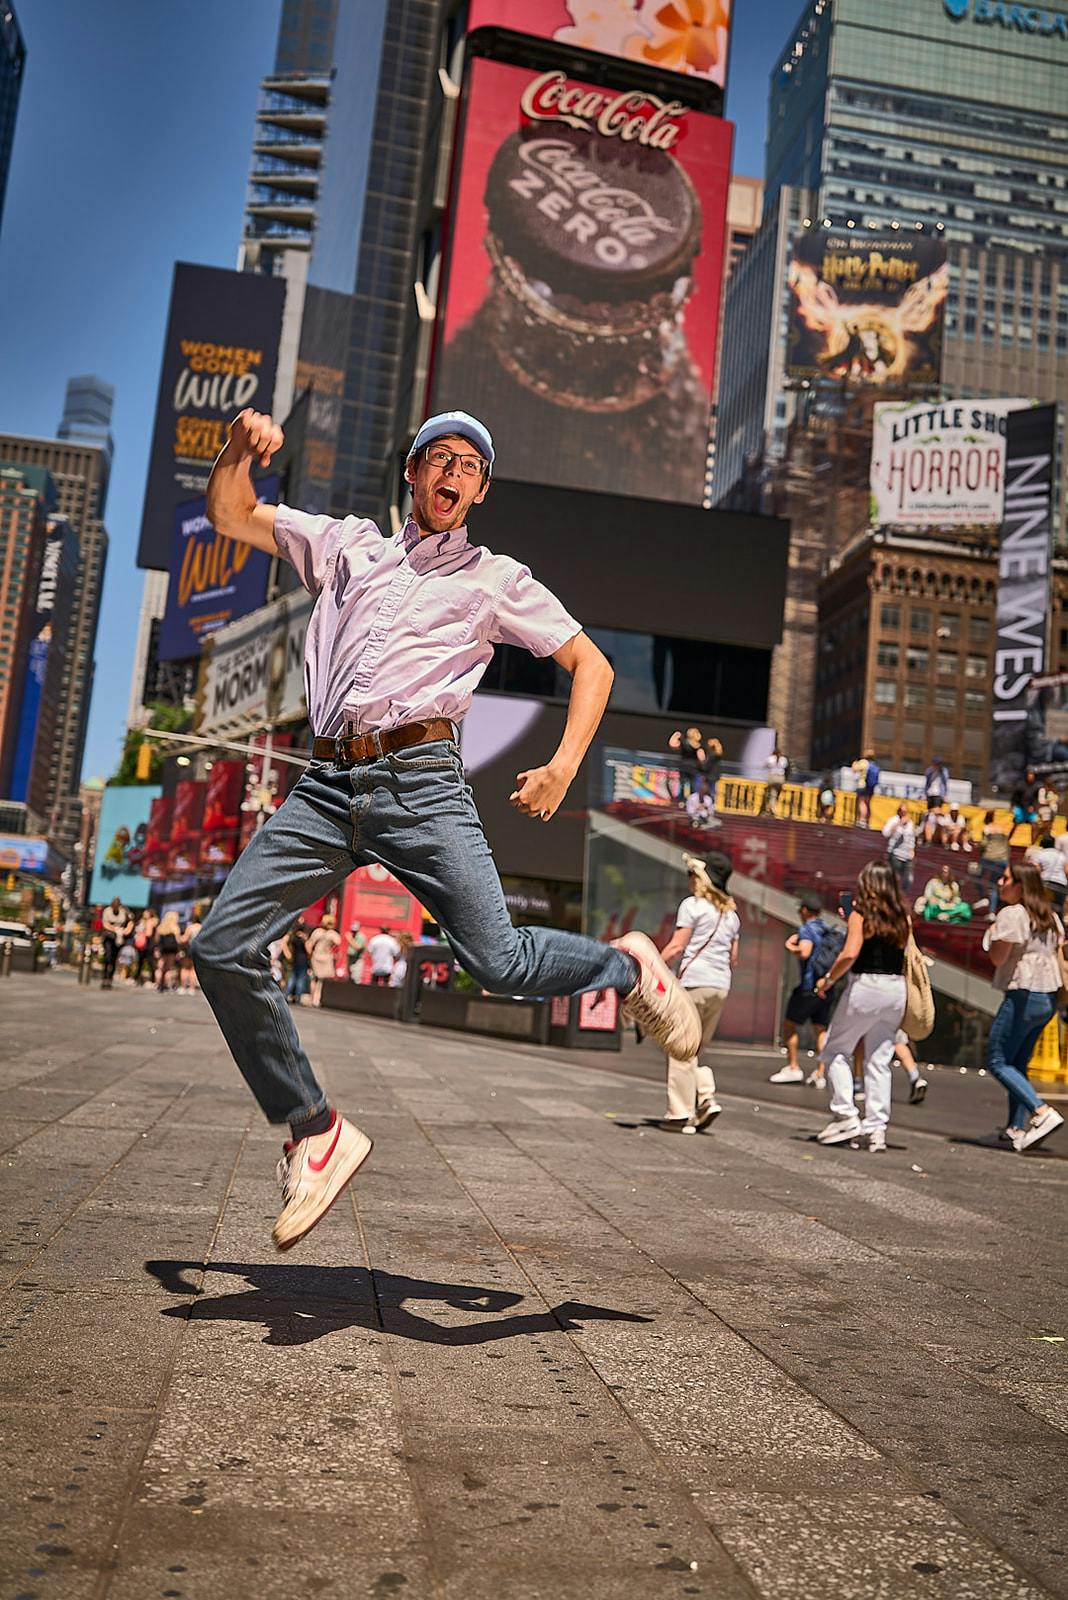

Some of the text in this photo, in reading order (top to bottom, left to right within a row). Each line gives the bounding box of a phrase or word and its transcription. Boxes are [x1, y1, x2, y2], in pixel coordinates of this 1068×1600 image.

[520, 71, 689, 150] Coca-Cola
[508, 170, 627, 265] ZERO
[180, 340, 263, 365] WOMEN
[174, 367, 259, 413] WILD
[891, 407, 963, 443] LITTLE
[887, 448, 1001, 509] HORROR
[1000, 455, 1051, 579] NINE
